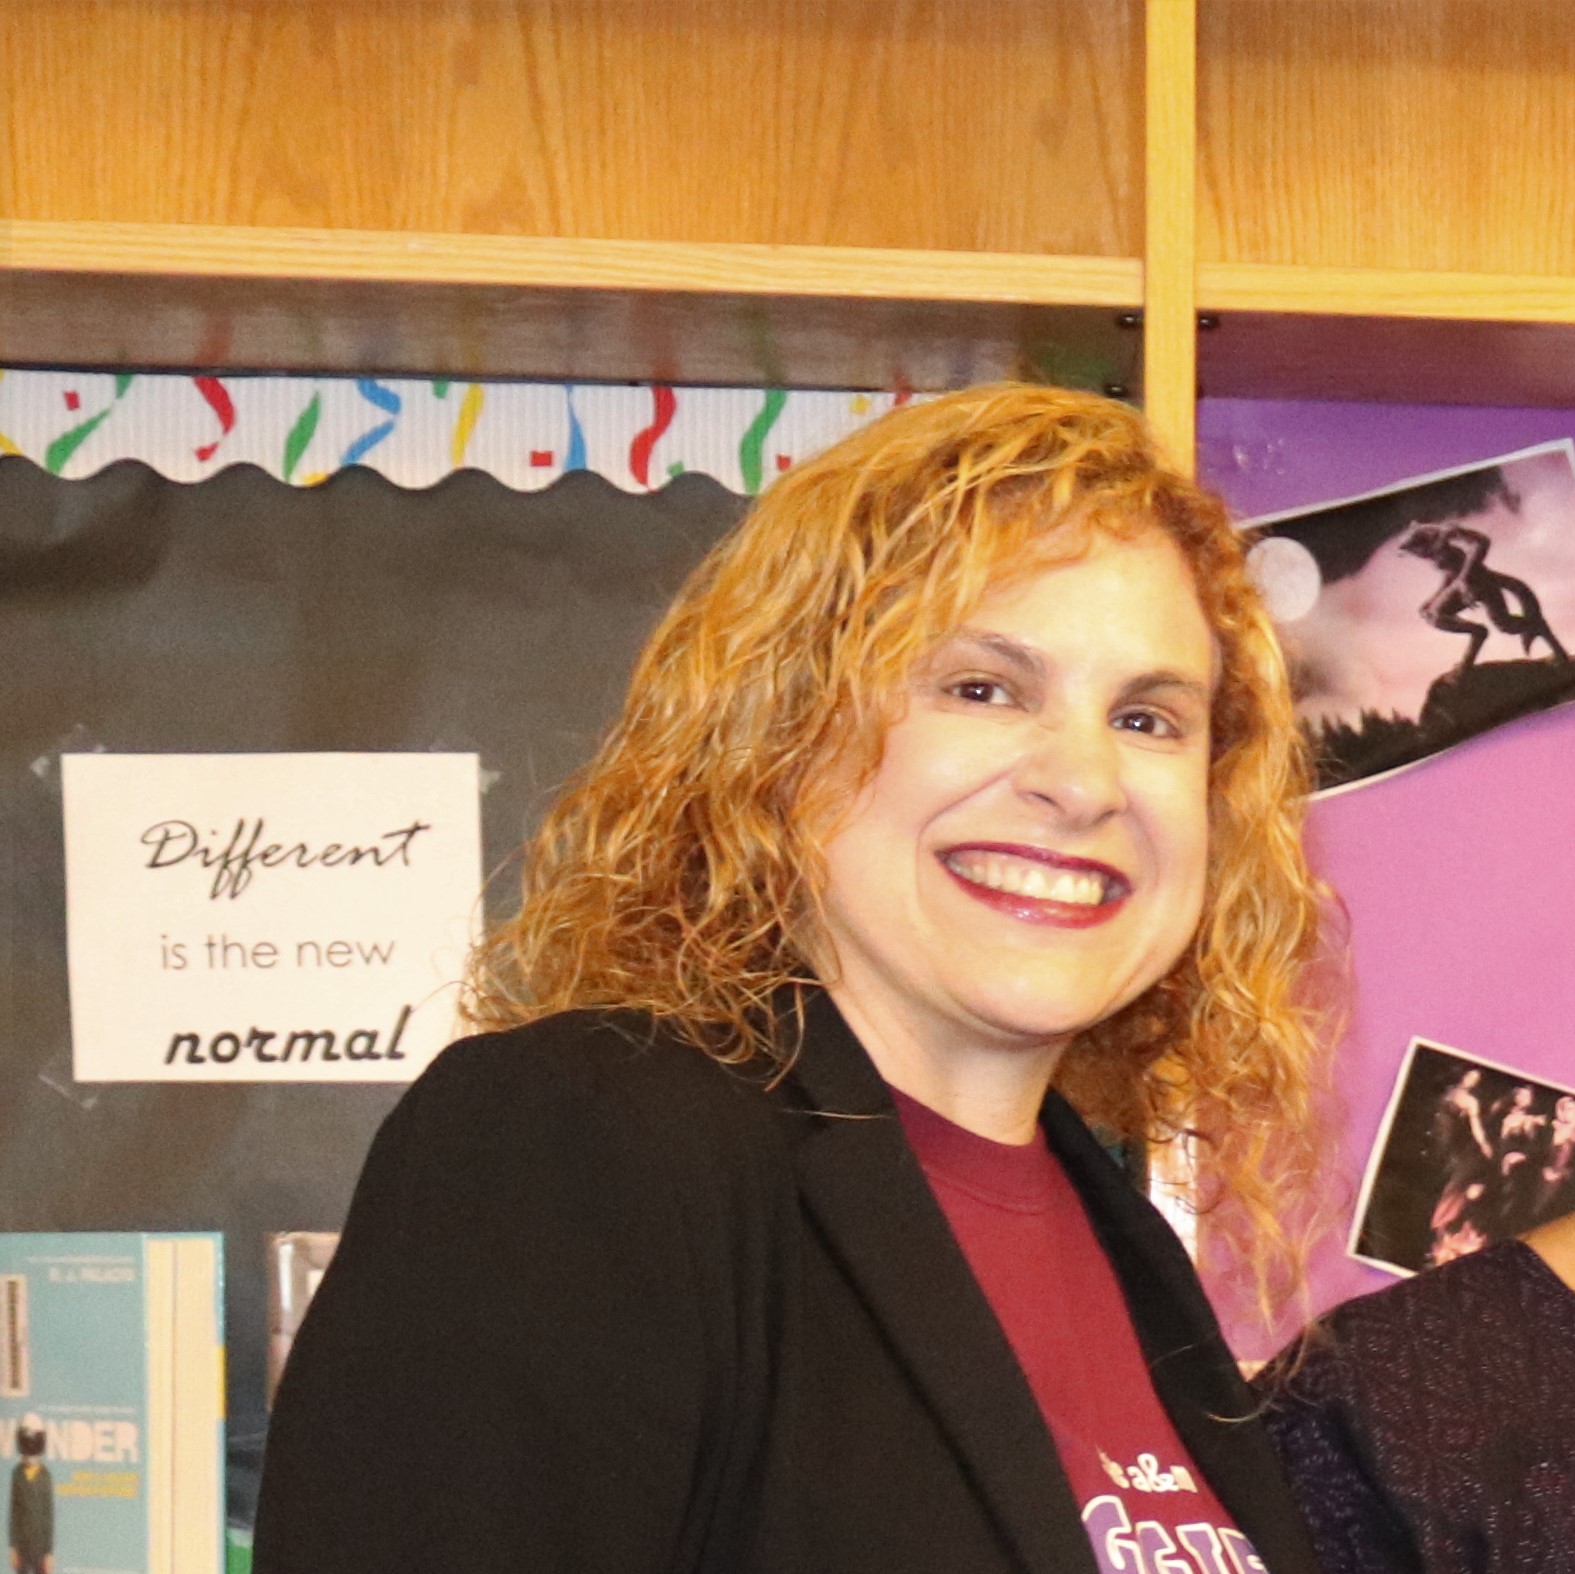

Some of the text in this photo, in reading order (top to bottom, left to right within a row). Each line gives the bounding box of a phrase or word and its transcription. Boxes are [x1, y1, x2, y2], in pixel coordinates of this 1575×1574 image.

[140, 818, 431, 900] Different
[161, 933, 395, 970] is the new
[164, 1004, 412, 1065] normal
